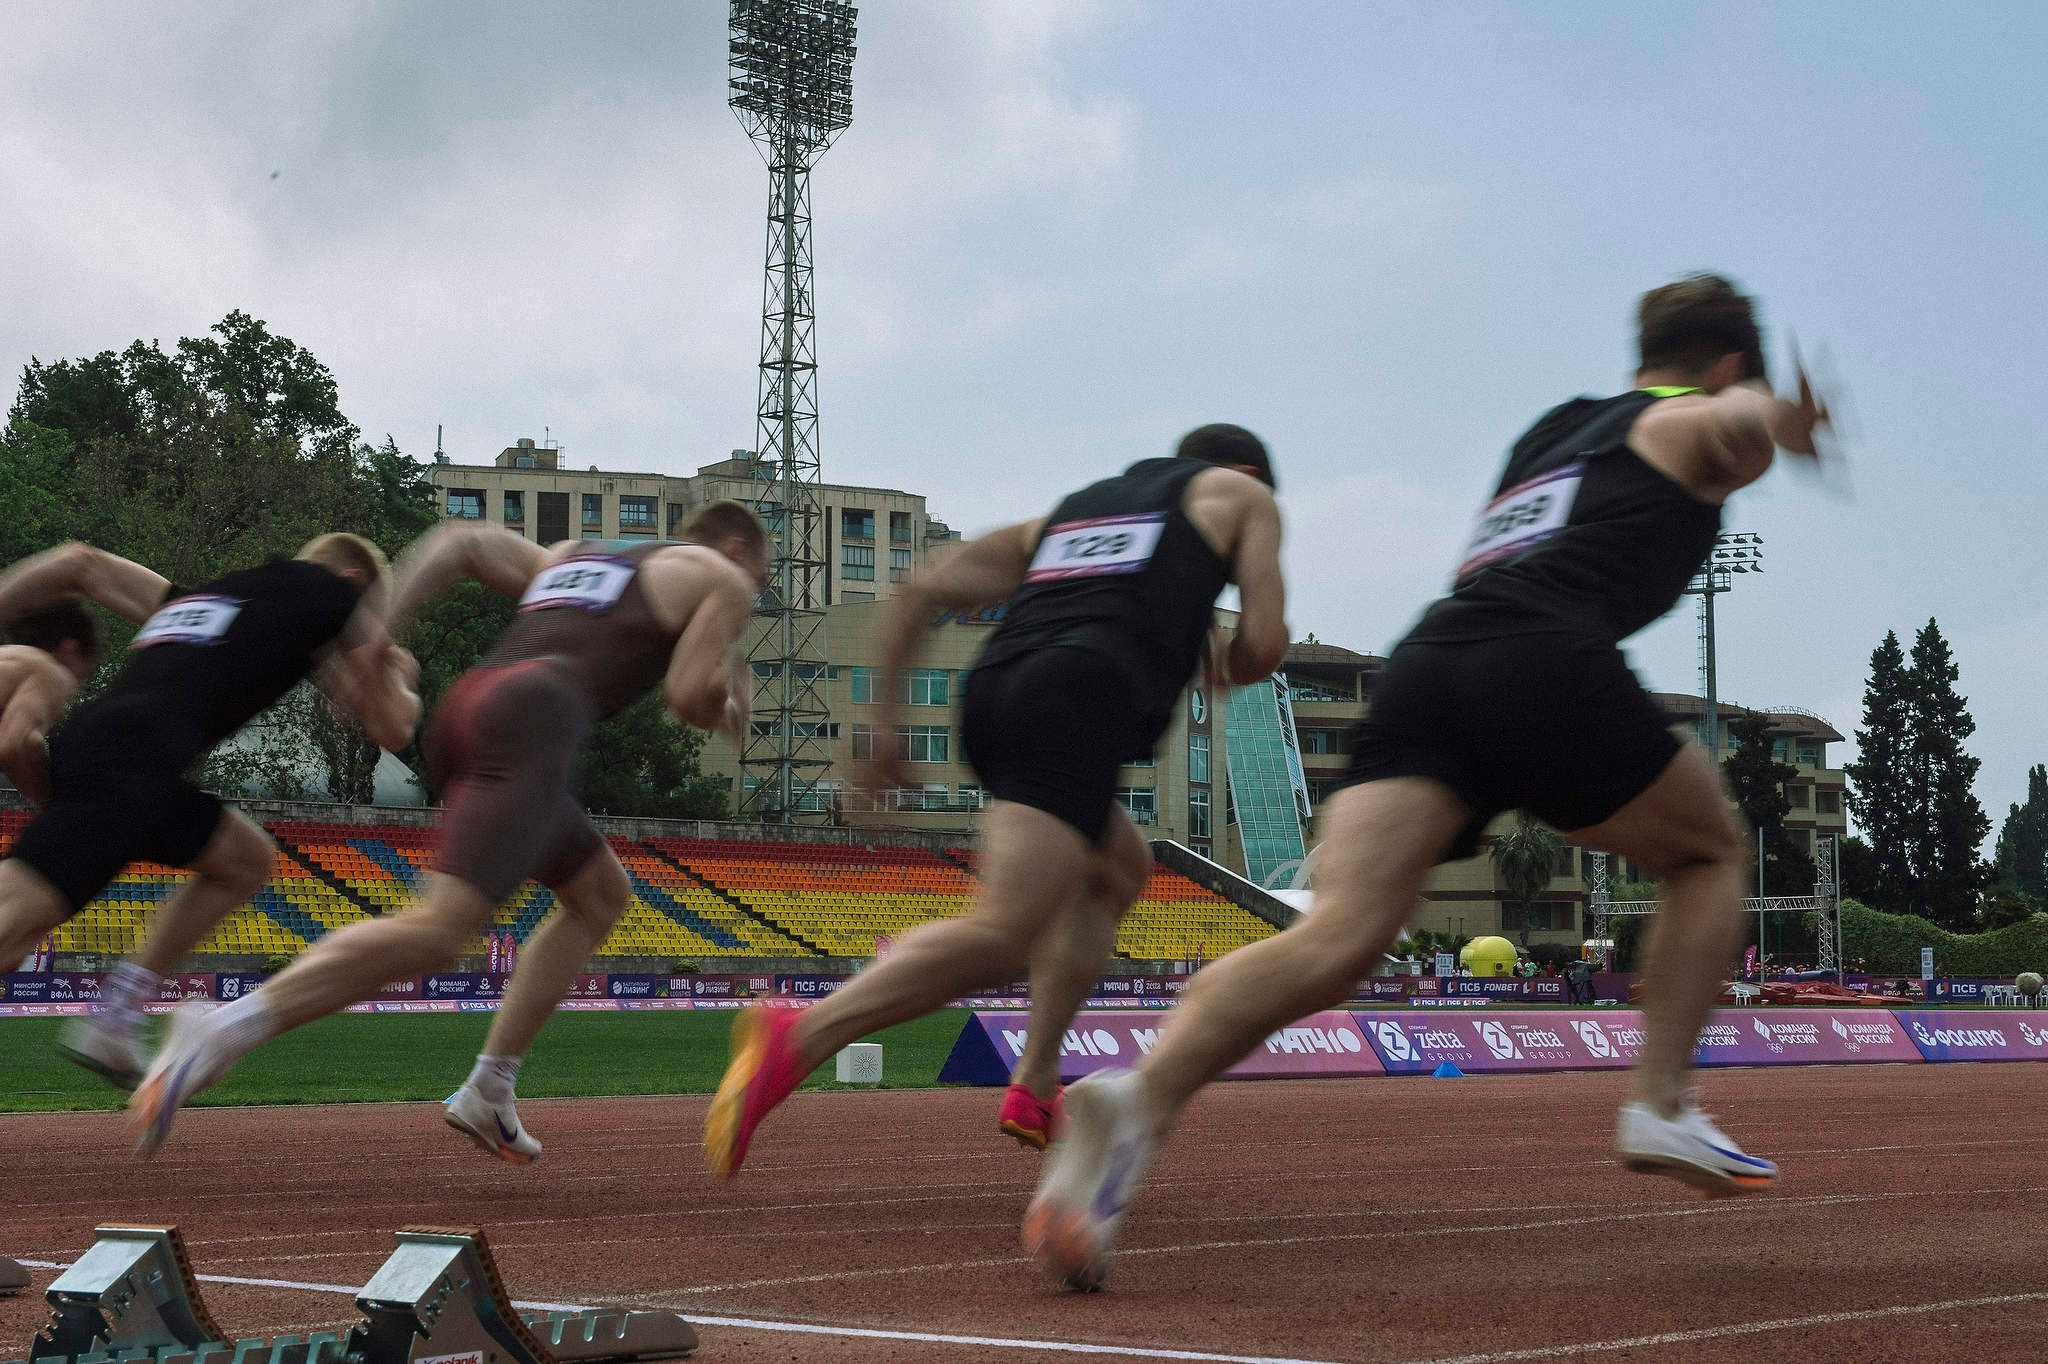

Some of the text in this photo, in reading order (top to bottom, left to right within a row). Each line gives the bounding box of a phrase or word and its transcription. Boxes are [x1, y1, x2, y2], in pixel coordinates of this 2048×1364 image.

[243, 982, 263, 992] zett
[670, 979, 691, 990] URAL
[750, 979, 769, 990] URAL
[795, 981, 816, 992] ПСБ
[818, 982, 848, 991] FONBE
[1419, 981, 1437, 990] URAL
[1460, 982, 1481, 992] ПСБ
[1484, 983, 1519, 992] FONBET
[1537, 983, 1560, 993] ПСБ
[1952, 984, 1977, 993] ПСБ
[50, 991, 74, 999] ВФЛА
[161, 991, 183, 999] ВФЛА
[622, 986, 650, 994] ЛИЗИНГ
[705, 986, 731, 994] ЛИЗИНГ
[1699, 1025, 1741, 1036] ОМАНДА
[1769, 1024, 1820, 1034] КОМАНДА
[1846, 1024, 1895, 1034] КОМАНДА
[1414, 1029, 1466, 1049] zetta
[1516, 1028, 1565, 1048] zetta
[1776, 1034, 1819, 1044] РОССИИ
[1853, 1034, 1894, 1044] РОССИИ
[1934, 1029, 2006, 1047] ФОСАГРО
[1427, 1052, 1473, 1061] GROUP
[1529, 1050, 1572, 1060] GROUP
